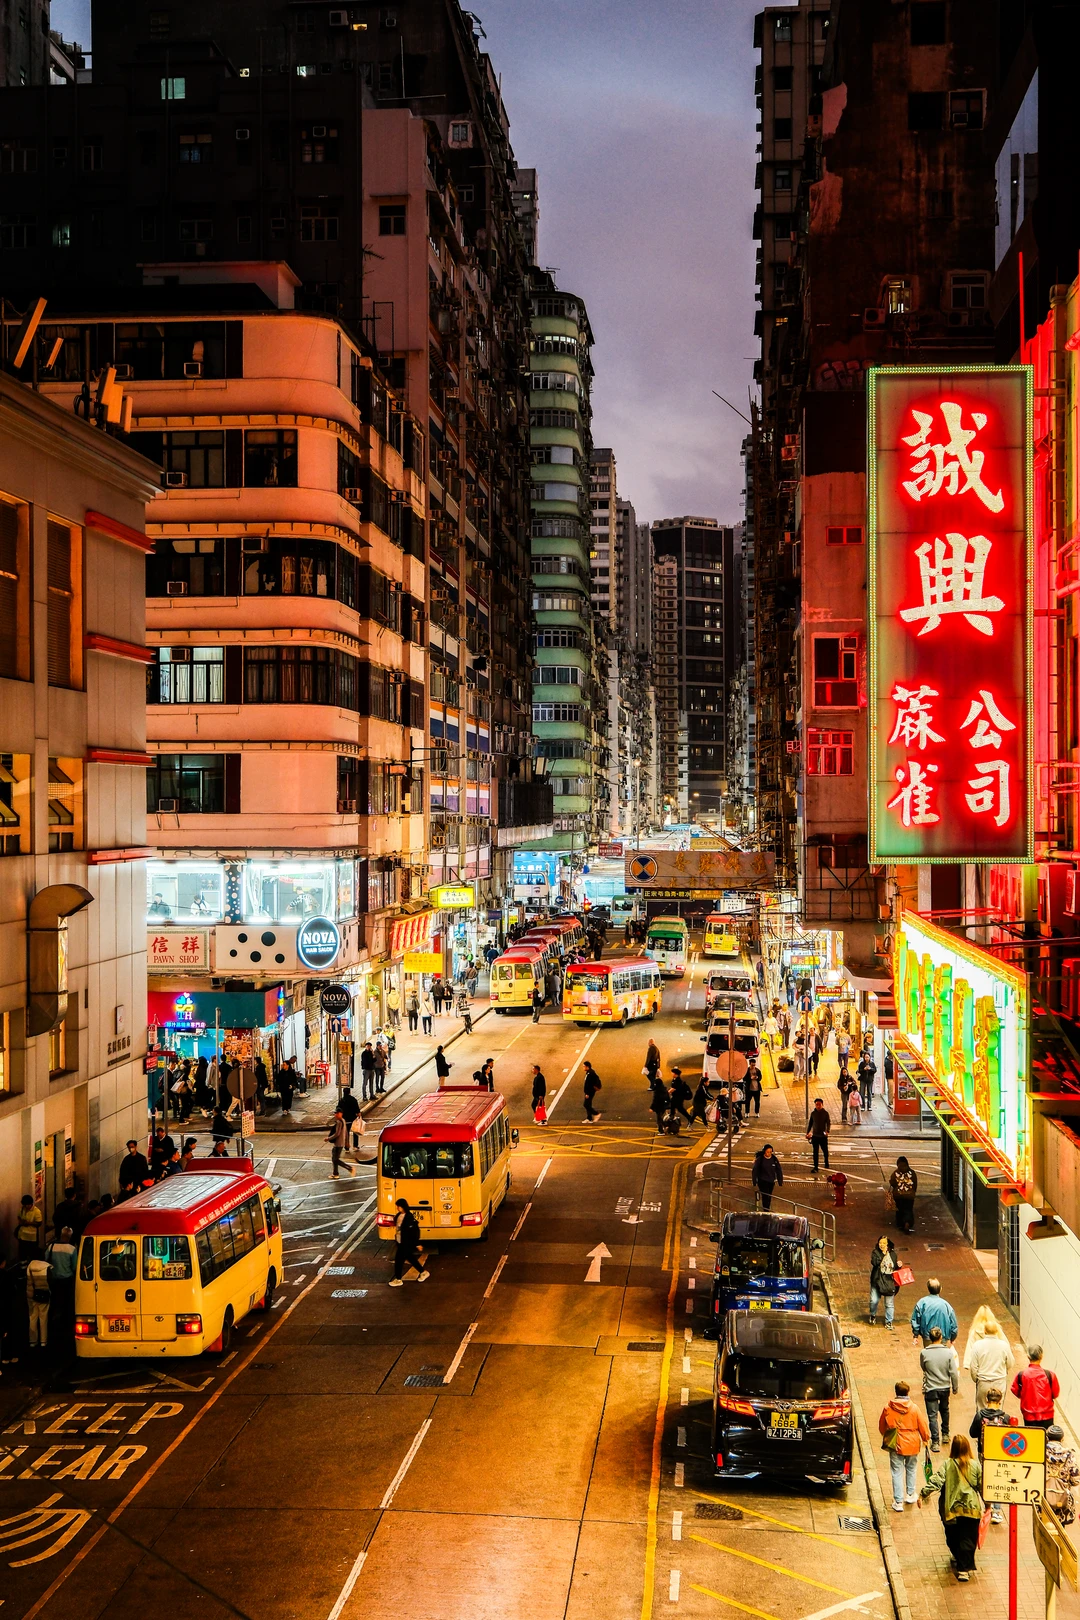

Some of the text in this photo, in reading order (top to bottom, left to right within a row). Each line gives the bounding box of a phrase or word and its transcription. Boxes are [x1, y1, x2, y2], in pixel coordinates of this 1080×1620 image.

[900, 402, 1005, 637] 誠興
[960, 689, 1016, 828] 公司
[303, 931, 336, 944] NOVA
[151, 936, 200, 954] 信祥
[153, 955, 175, 963] PAWN
[179, 955, 200, 963] SHOP
[323, 993, 348, 1001] NOVA
[178, 1011, 193, 1020] TH
[1, 1402, 185, 1435] KEEP
[993, 1469, 1012, 1478] 上午
[1022, 1465, 1032, 1479] 7
[986, 1484, 1019, 1492] midnight
[993, 1492, 1012, 1501] 午夜
[1023, 1488, 1041, 1503] 12
